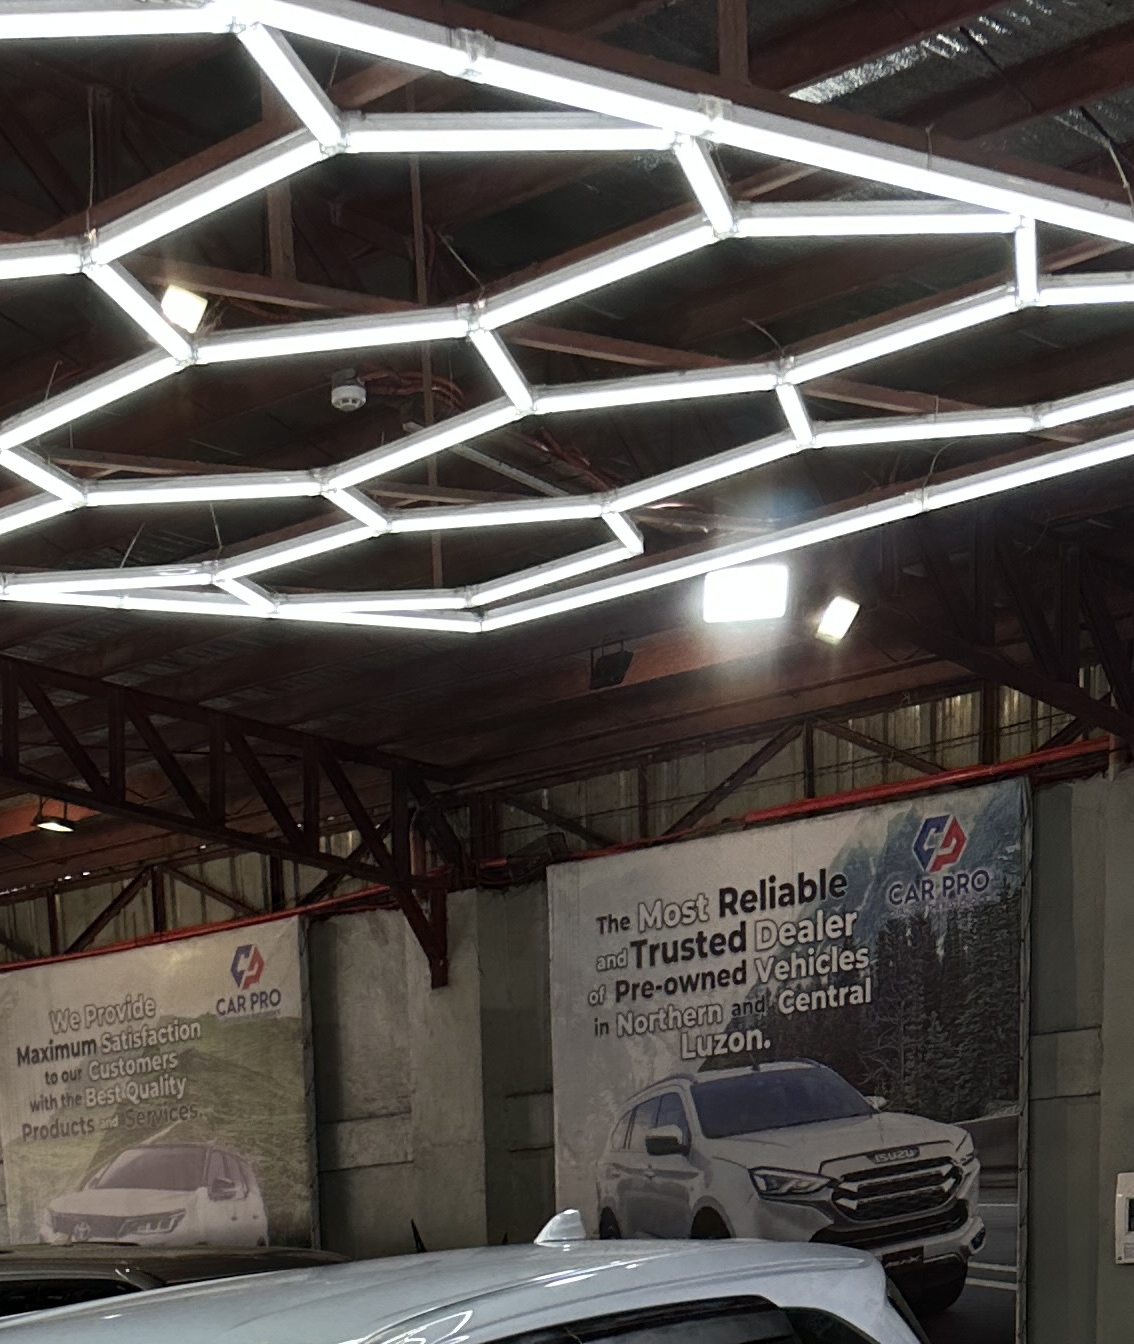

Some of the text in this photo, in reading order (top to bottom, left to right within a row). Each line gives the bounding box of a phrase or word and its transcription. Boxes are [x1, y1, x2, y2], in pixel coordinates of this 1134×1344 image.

[596, 914, 631, 936] The
[638, 894, 710, 933] Most
[719, 868, 847, 918] Reliable
[888, 870, 989, 905] CAR PRO
[596, 910, 857, 972] and Trusted Dealer
[588, 945, 870, 1007] of Pre-owned Vehicles
[49, 993, 157, 1034] We Provide
[216, 995, 247, 1016] CAR
[250, 988, 281, 1011] PRO
[594, 977, 872, 1038] in Northern and Central
[16, 1019, 202, 1067] Maximum Satisfaction
[681, 1028, 771, 1060] Luzon.
[44, 1050, 179, 1085] to our Customers
[29, 1074, 187, 1112] with the Best Quality
[22, 1103, 203, 1142] Products and Services.
